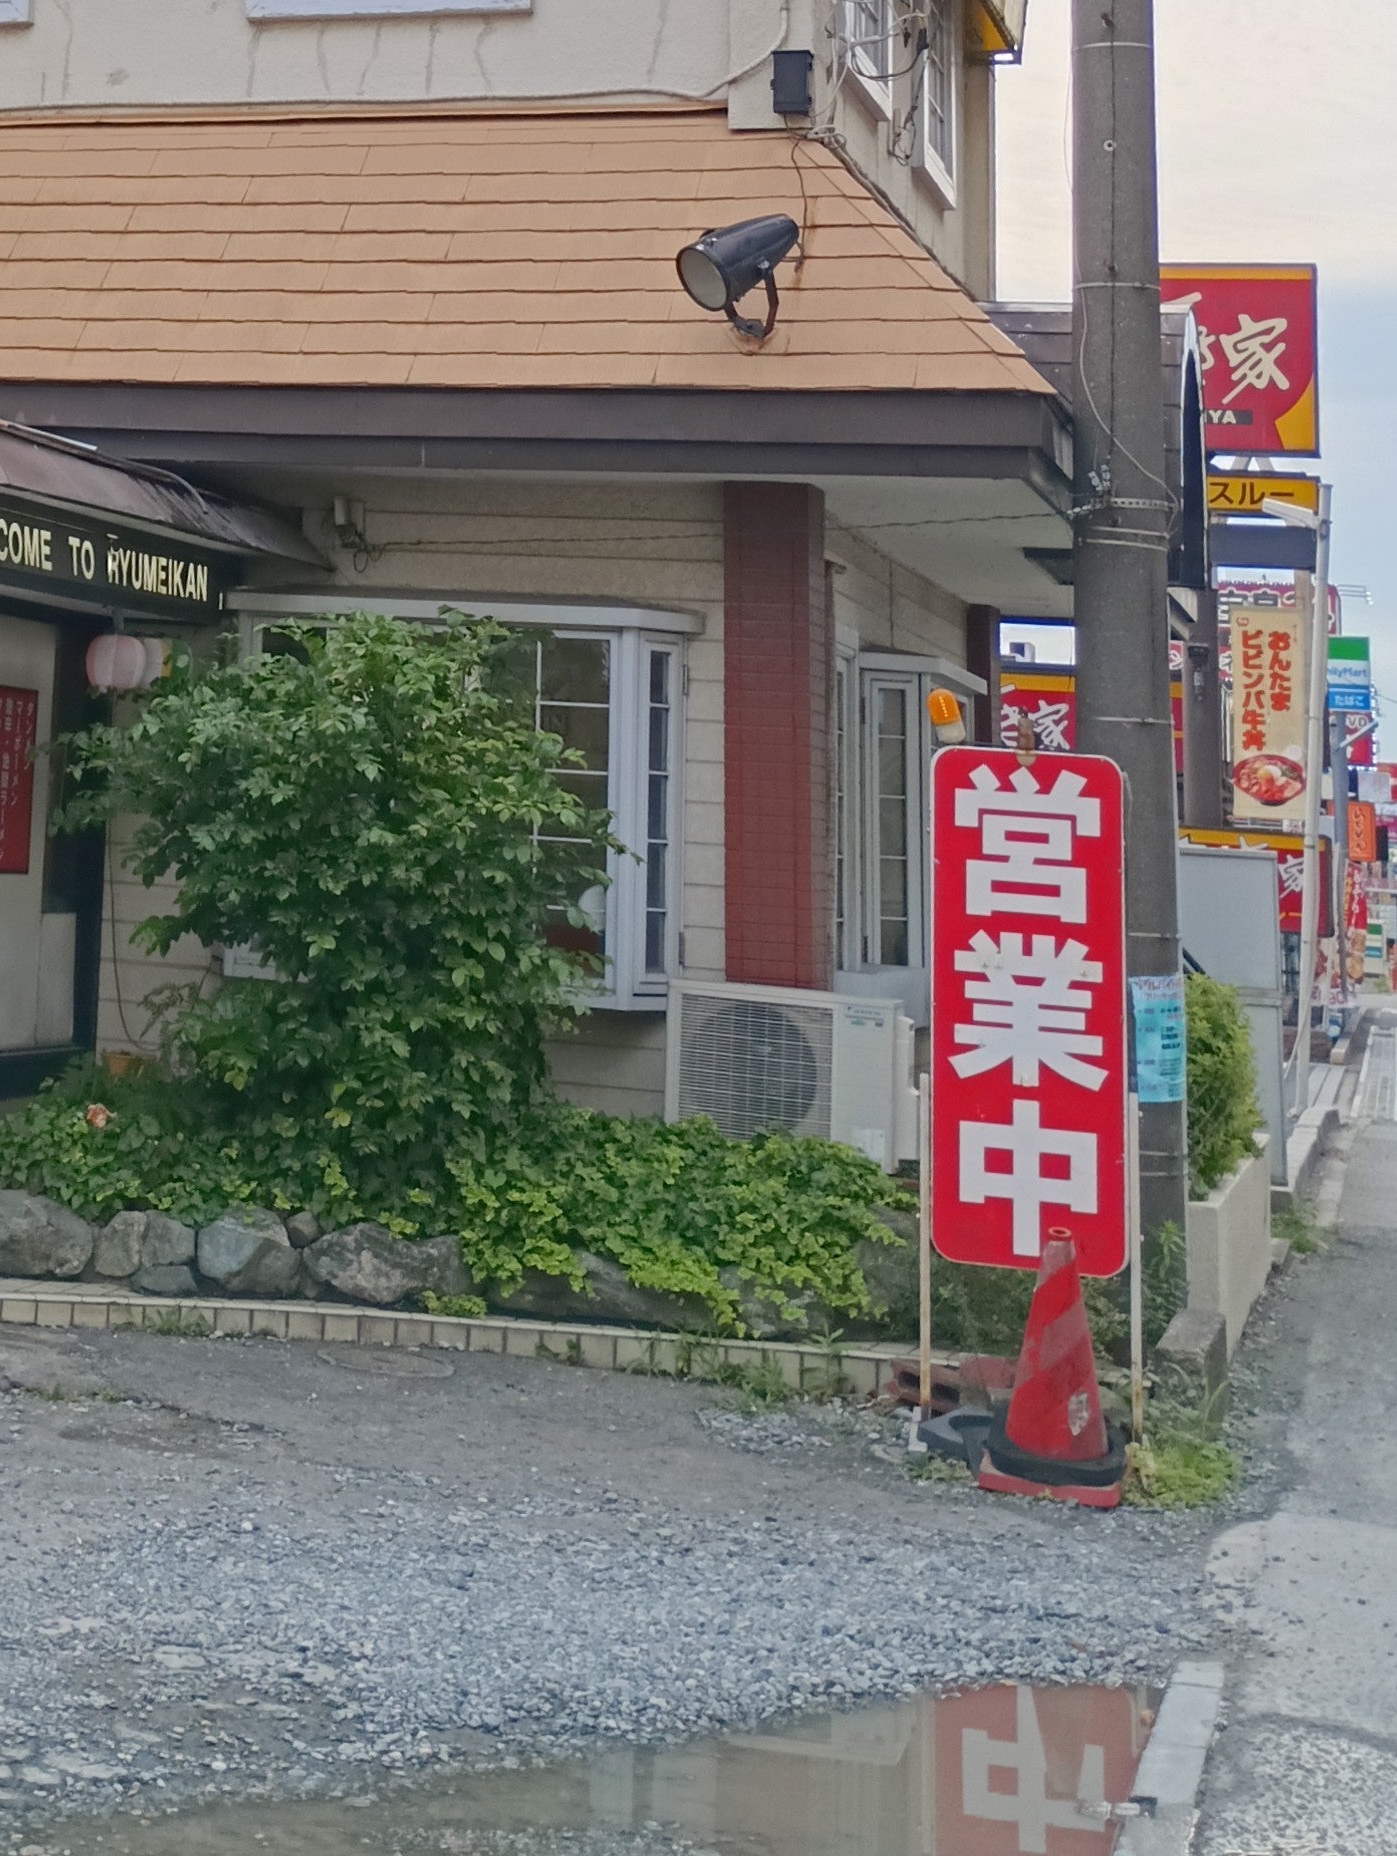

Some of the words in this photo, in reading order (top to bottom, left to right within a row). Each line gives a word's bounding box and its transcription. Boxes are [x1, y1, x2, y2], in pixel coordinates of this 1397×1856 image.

[1209, 481, 1294, 506] スルー
[68, 535, 95, 580] TO
[107, 546, 208, 602] RYUMEIKAN
[1242, 630, 1266, 751] ビビンバ牛丼
[1268, 631, 1292, 711] おんたま
[1334, 695, 1366, 707] たばこ
[948, 763, 1109, 1258] 営業中
